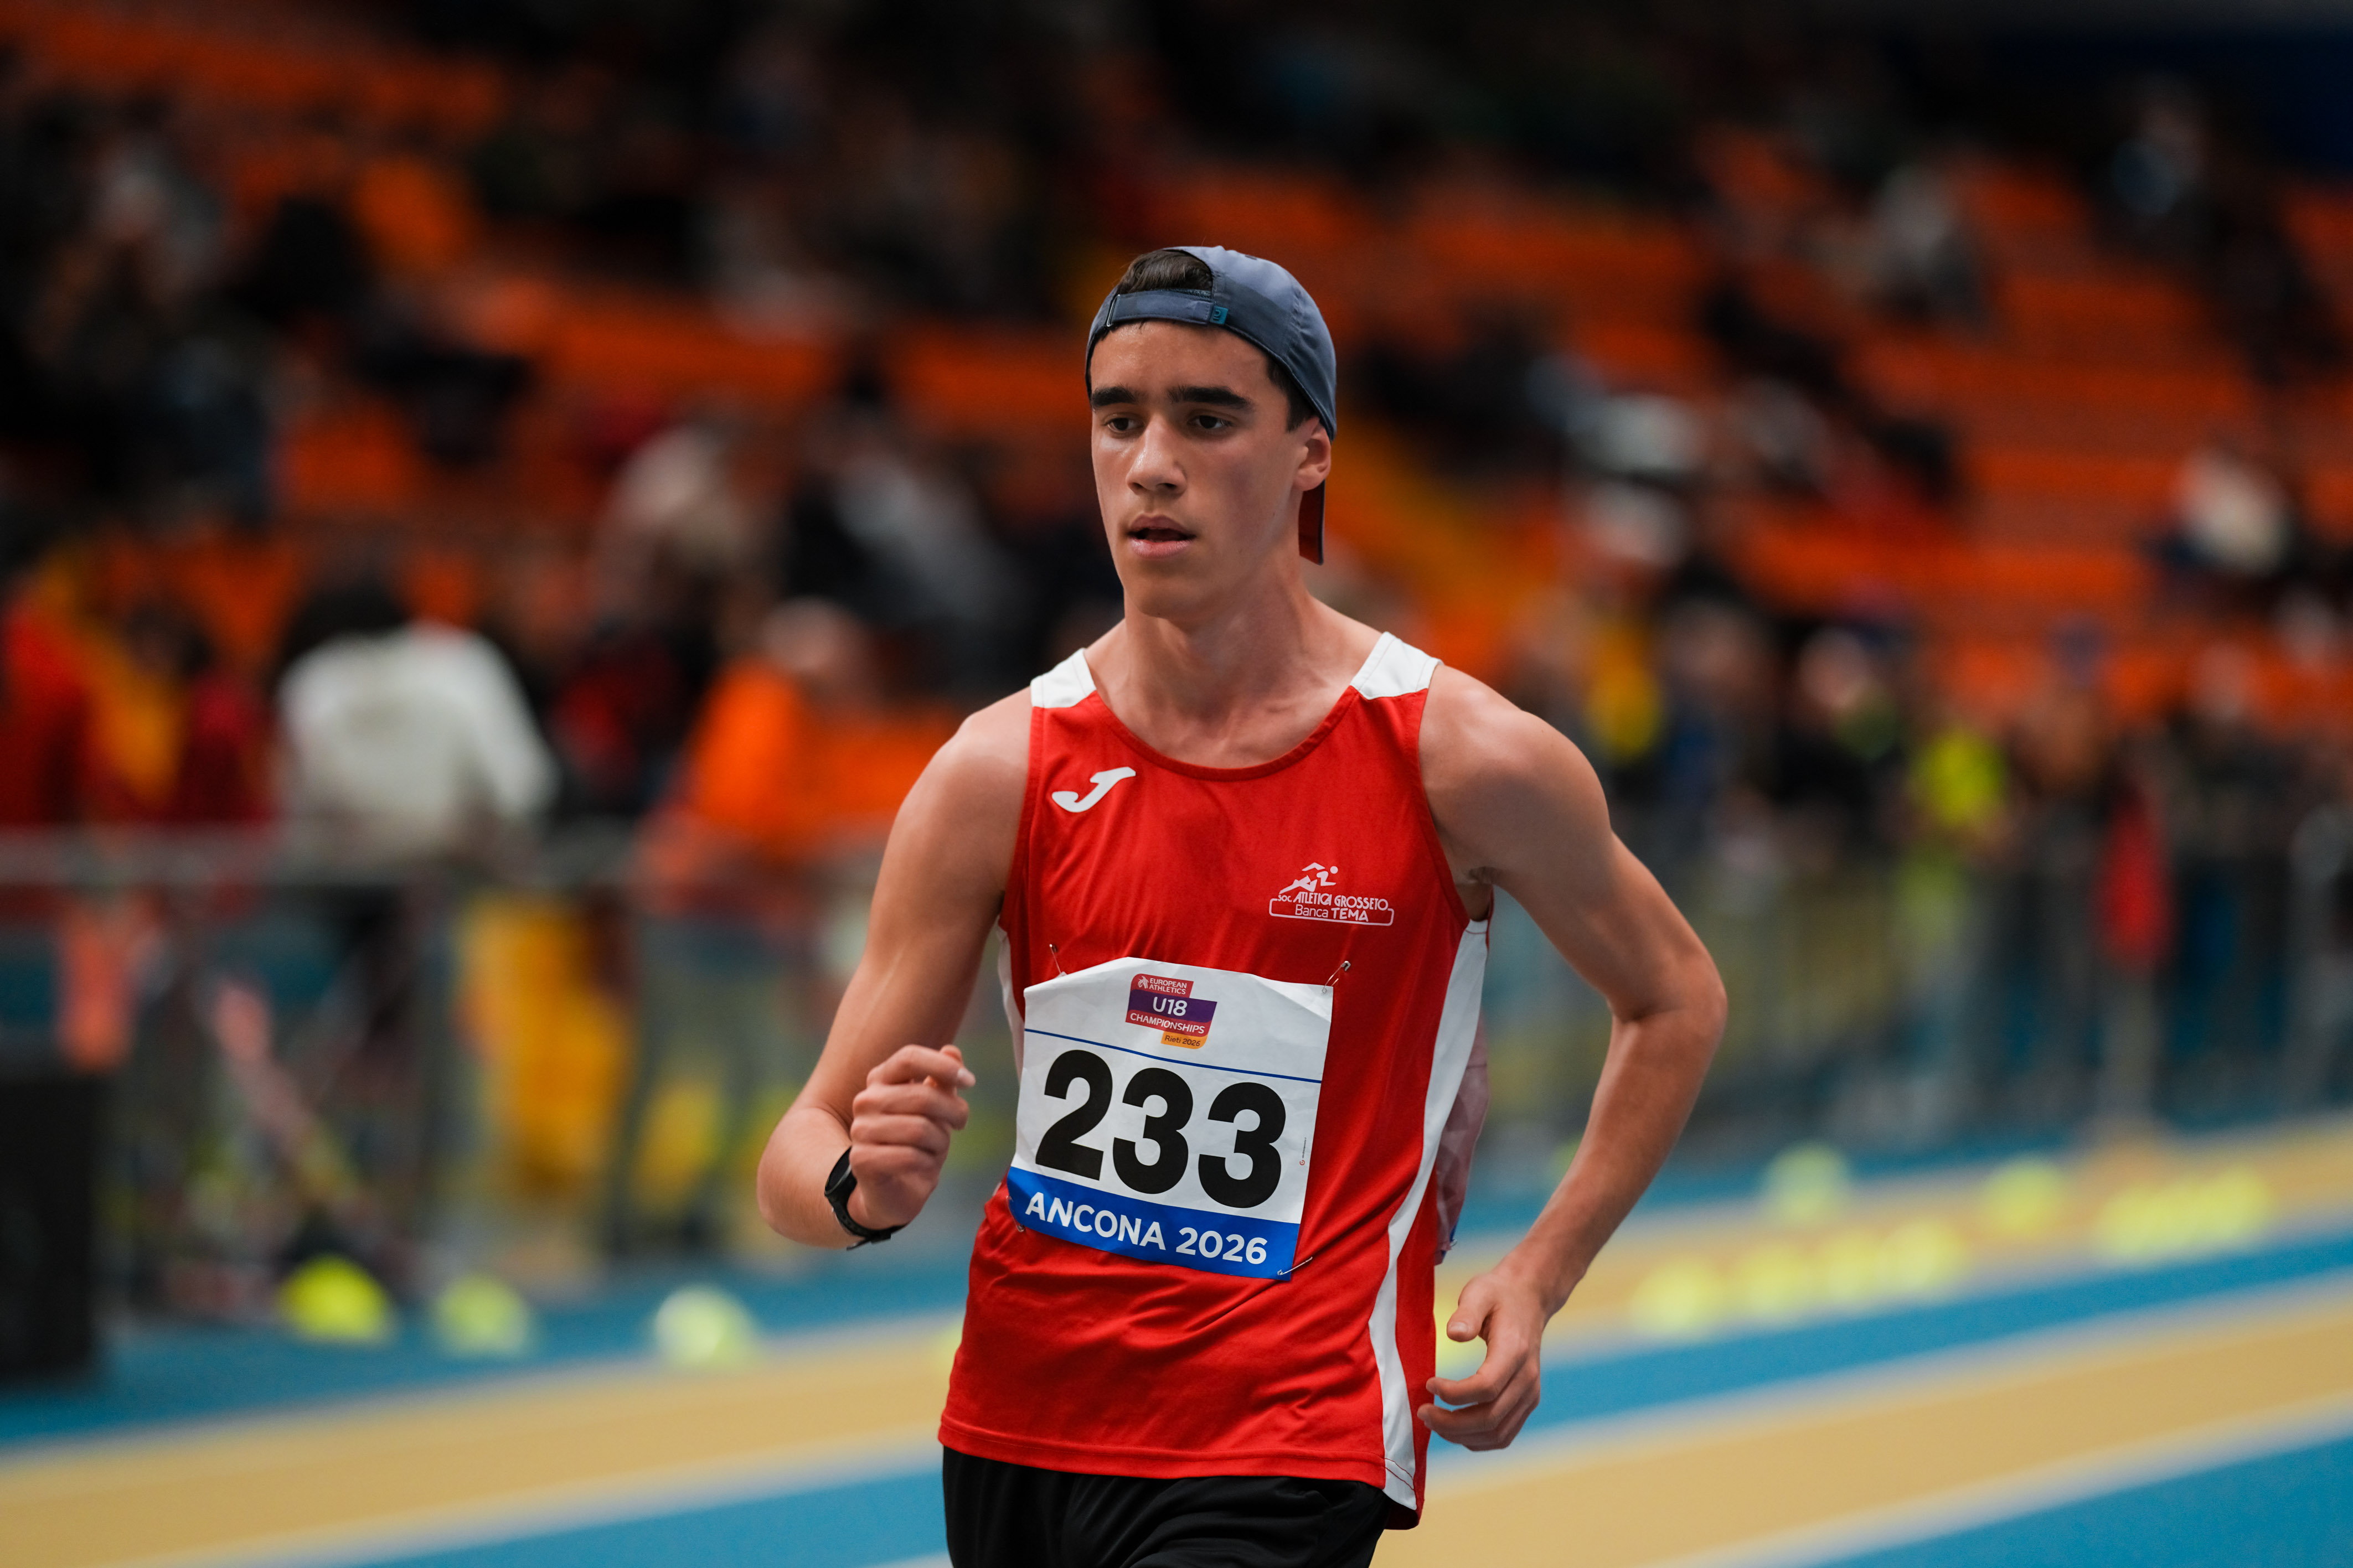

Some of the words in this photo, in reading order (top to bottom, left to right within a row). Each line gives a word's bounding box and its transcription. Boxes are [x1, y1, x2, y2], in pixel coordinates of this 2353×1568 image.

[1293, 892, 1332, 905] ATLETICA
[1334, 895, 1389, 910] GROSSETO
[1295, 905, 1328, 918] Banca
[1331, 908, 1369, 922] TEMA
[1149, 984, 1186, 995] ATHLETICS
[1150, 978, 1187, 989] EUROPEAN
[1153, 997, 1188, 1016] U18
[1130, 1013, 1205, 1034] CHAMPIONSHIPS
[1165, 1035, 1182, 1043] Rieti
[1183, 1038, 1201, 1047] 2026
[1035, 1049, 1286, 1208] 233
[1025, 1192, 1166, 1250] ANCONA
[1176, 1227, 1268, 1265] 2026
